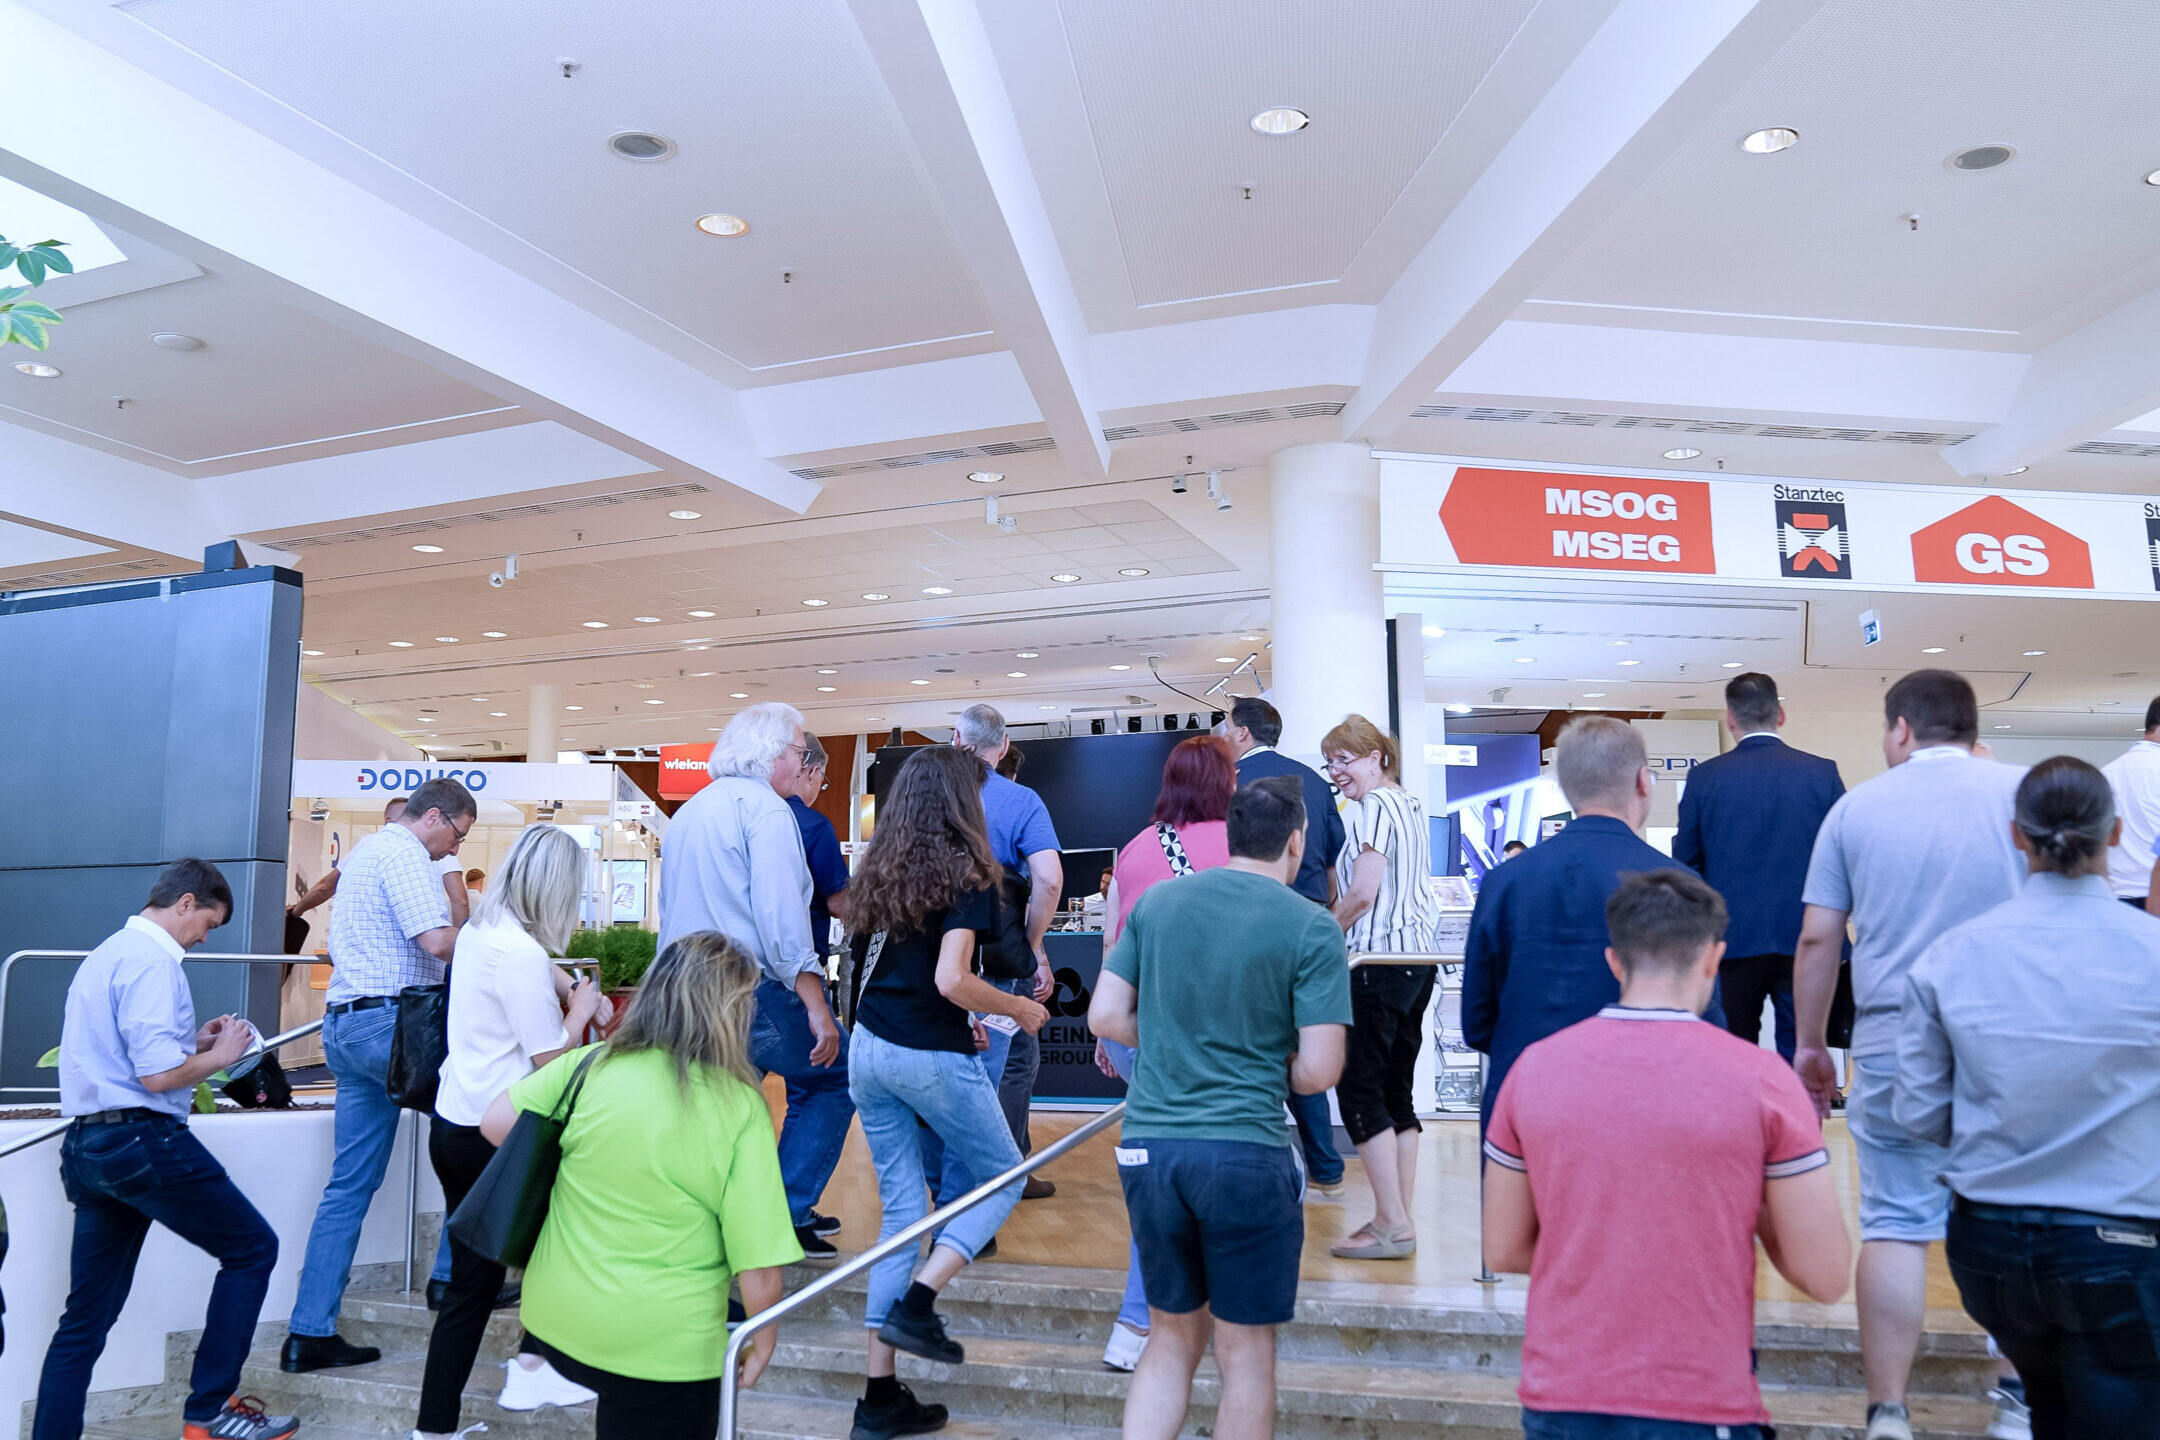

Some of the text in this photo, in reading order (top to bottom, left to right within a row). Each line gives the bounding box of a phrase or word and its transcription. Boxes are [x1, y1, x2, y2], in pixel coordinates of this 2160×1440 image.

[1545, 487, 1678, 522] MSOG
[1773, 484, 1845, 502] Stanztec
[2144, 502, 2160, 518] St
[1552, 530, 1681, 563] MSEG
[1955, 532, 2050, 576] GS
